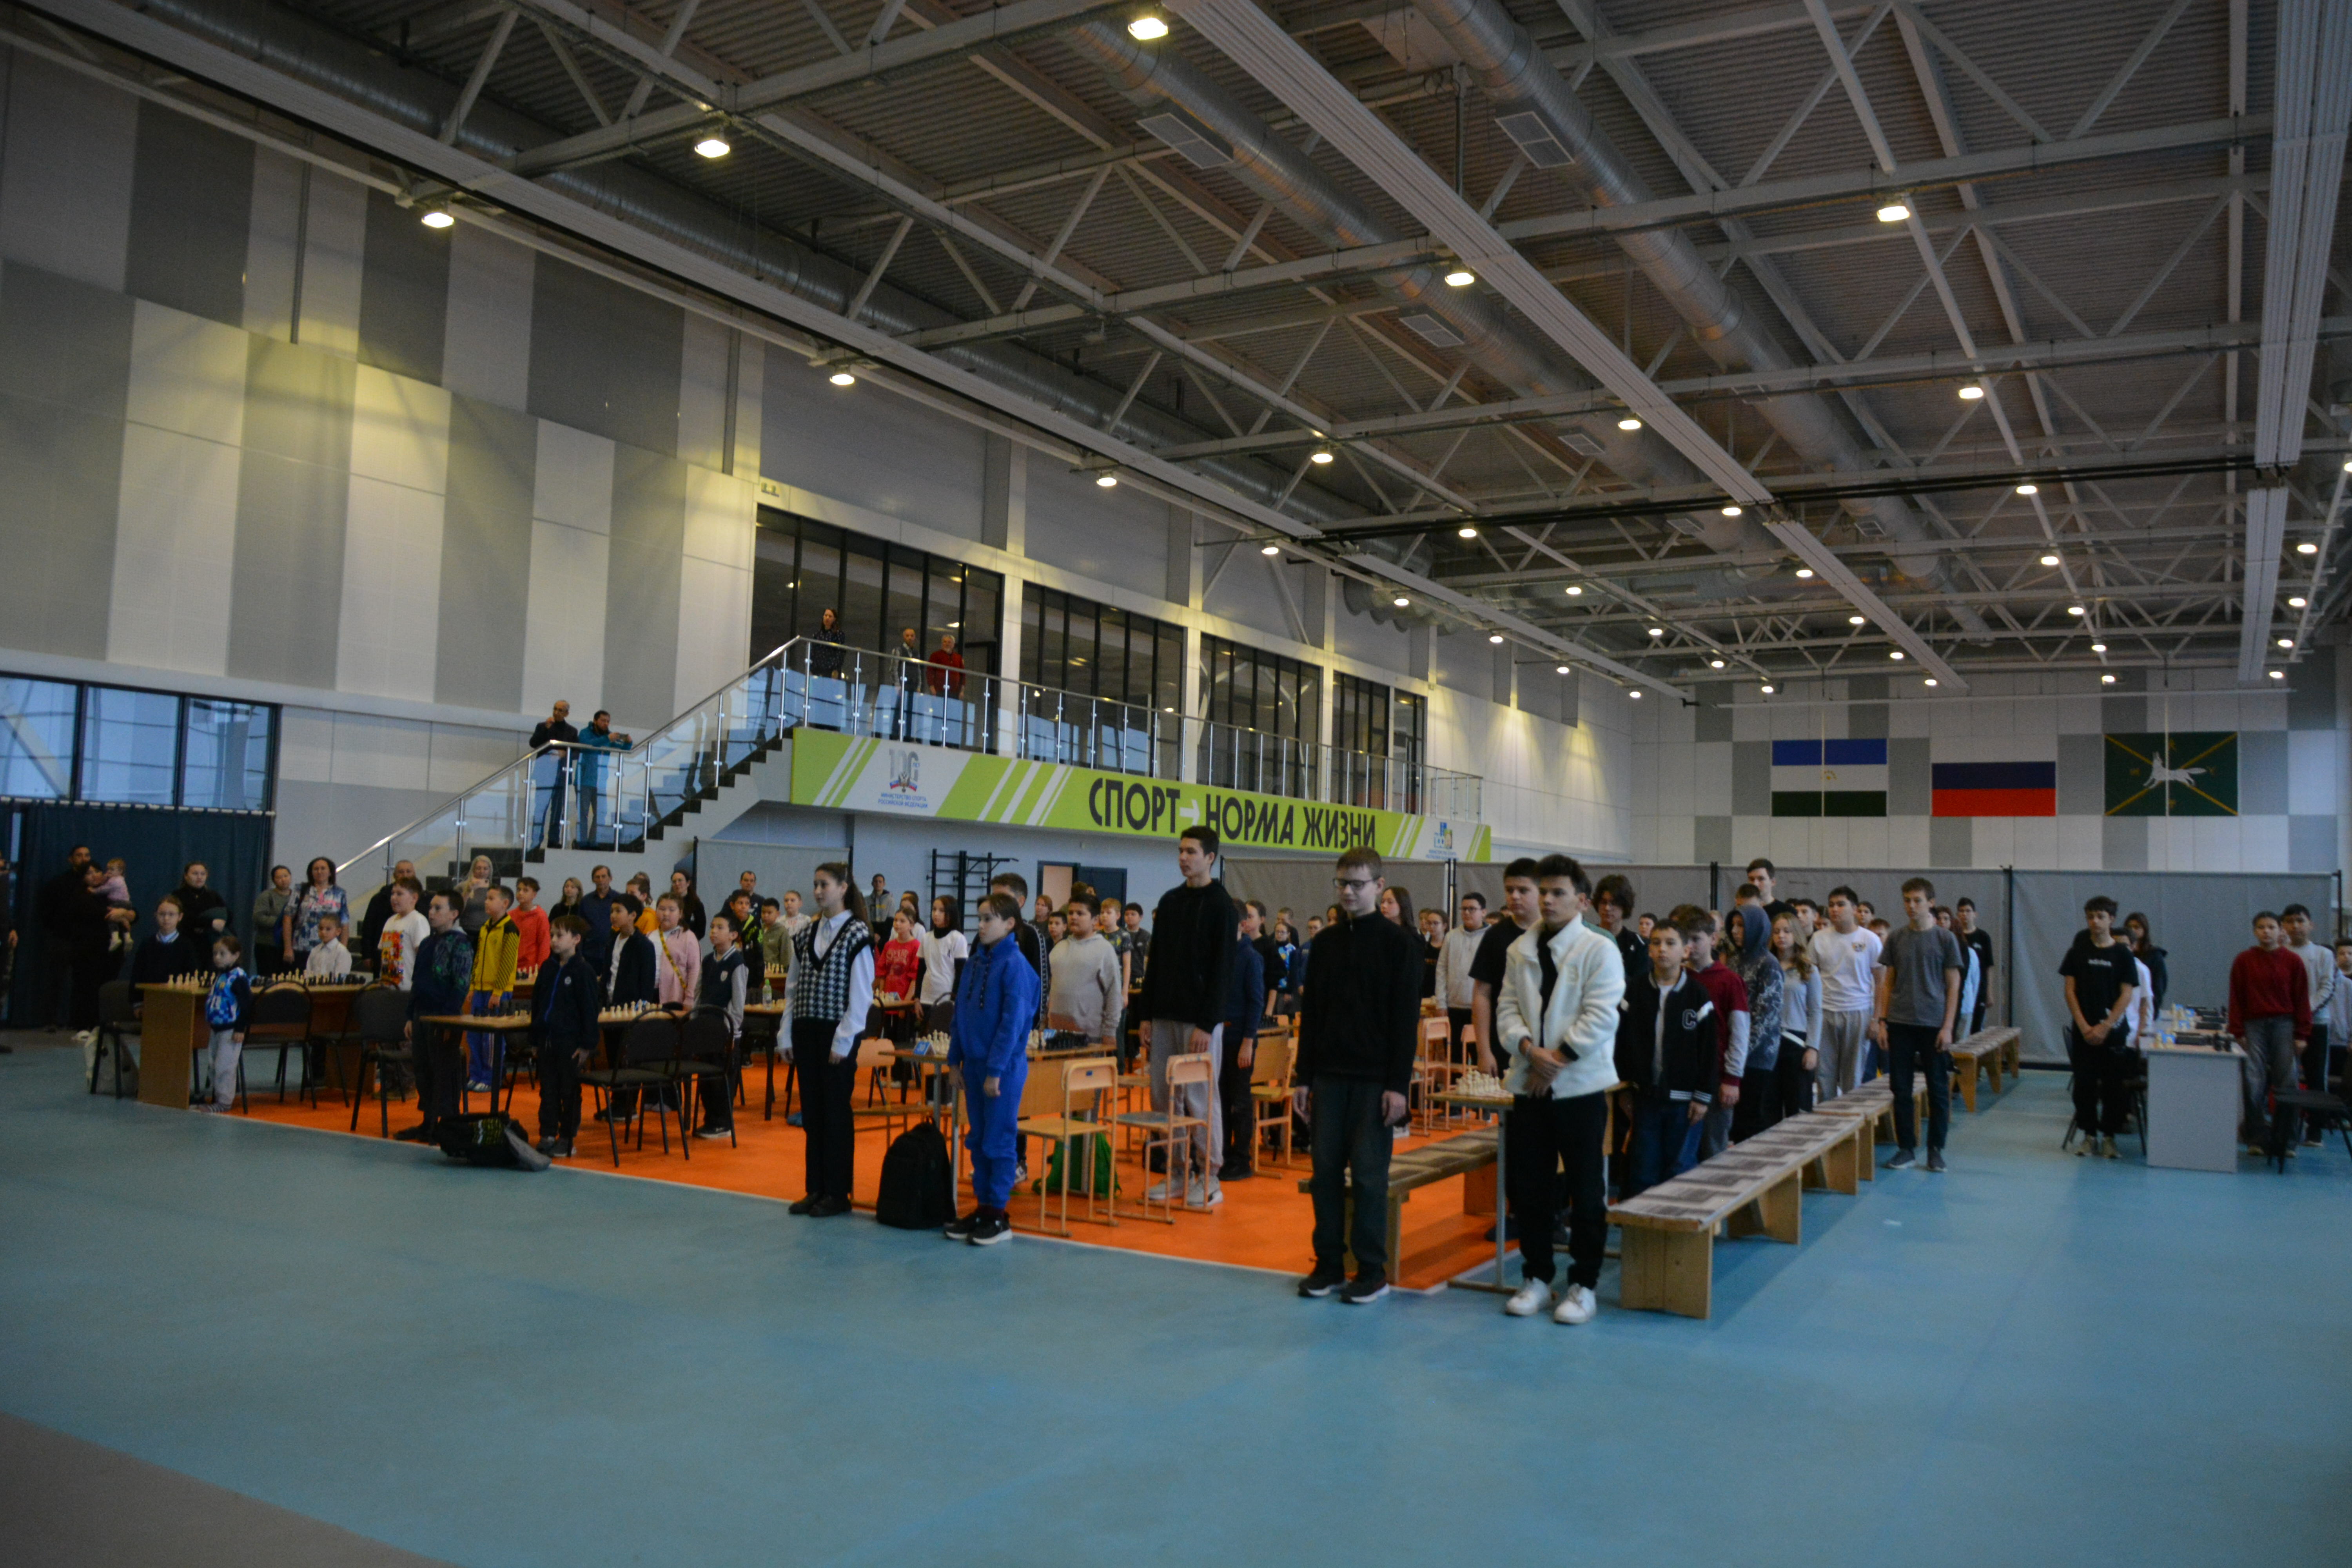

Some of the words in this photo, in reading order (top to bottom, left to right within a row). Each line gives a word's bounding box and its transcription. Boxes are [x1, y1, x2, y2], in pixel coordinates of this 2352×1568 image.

[1089, 778, 1180, 833] СПОРТ
[1206, 794, 1294, 844] НОРМА
[1302, 806, 1375, 849] ЖИЗНИ
